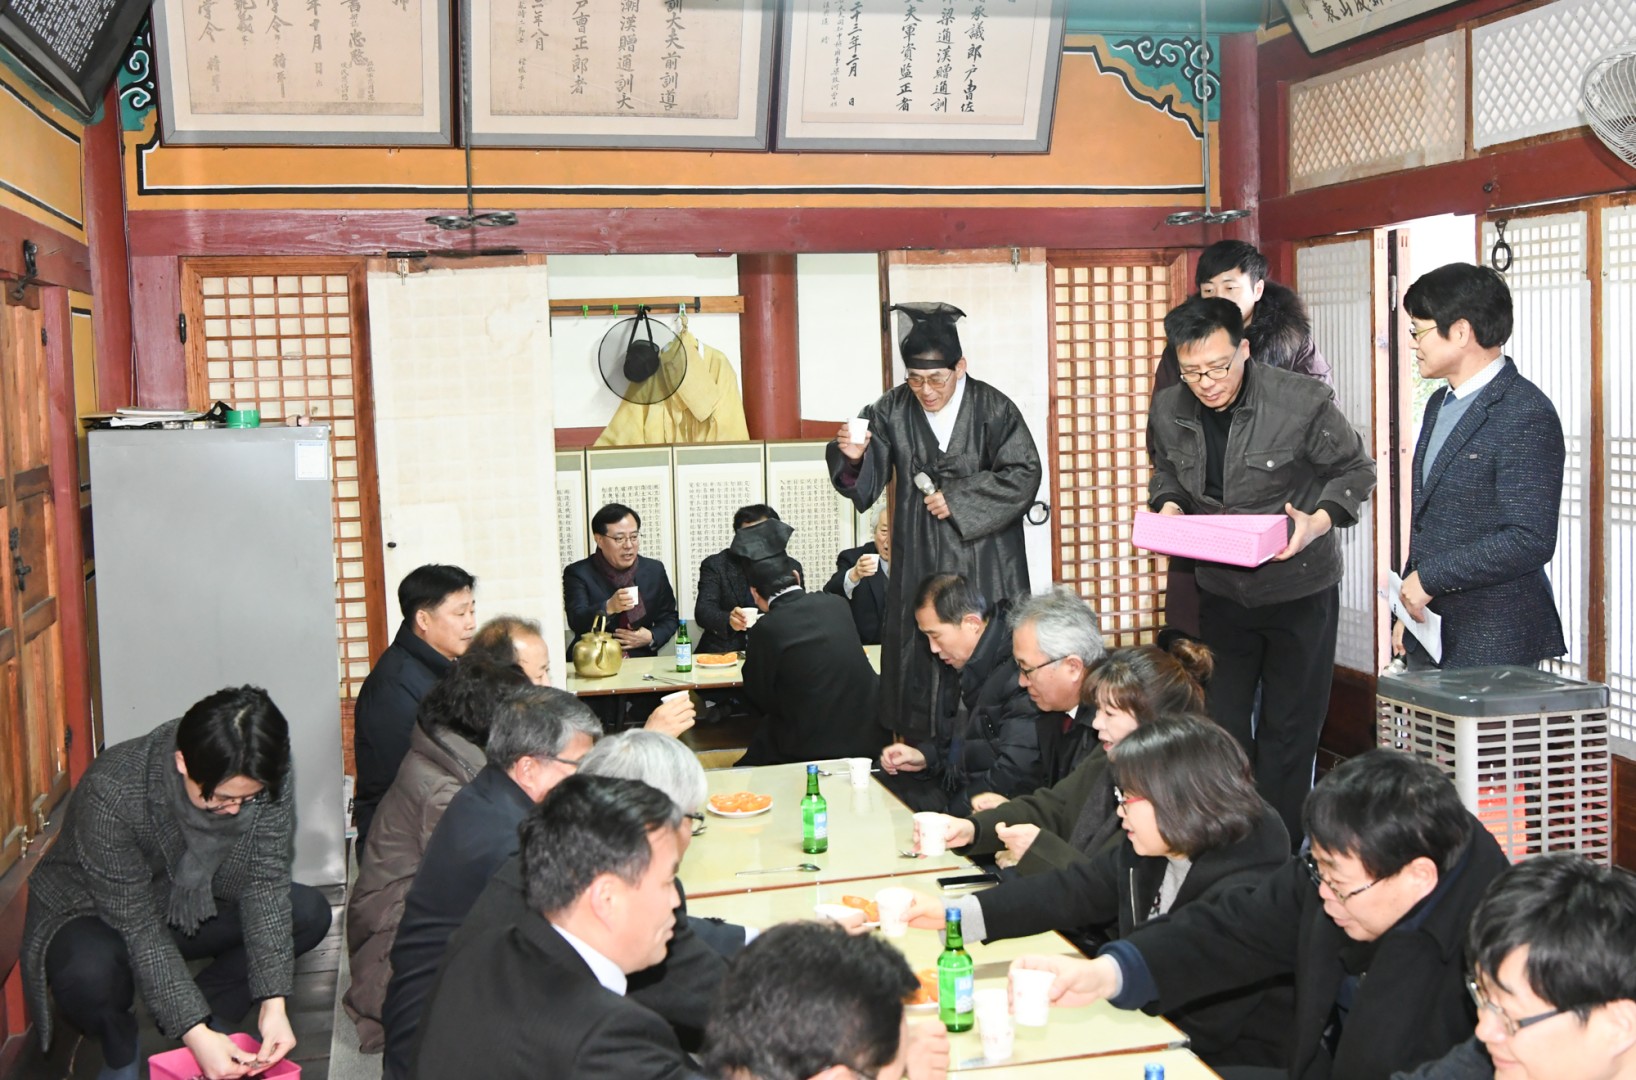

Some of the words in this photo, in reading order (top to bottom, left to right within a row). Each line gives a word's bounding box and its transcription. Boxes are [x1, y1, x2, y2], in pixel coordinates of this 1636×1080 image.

[896, 0, 923, 112] 夫軍資監正者
